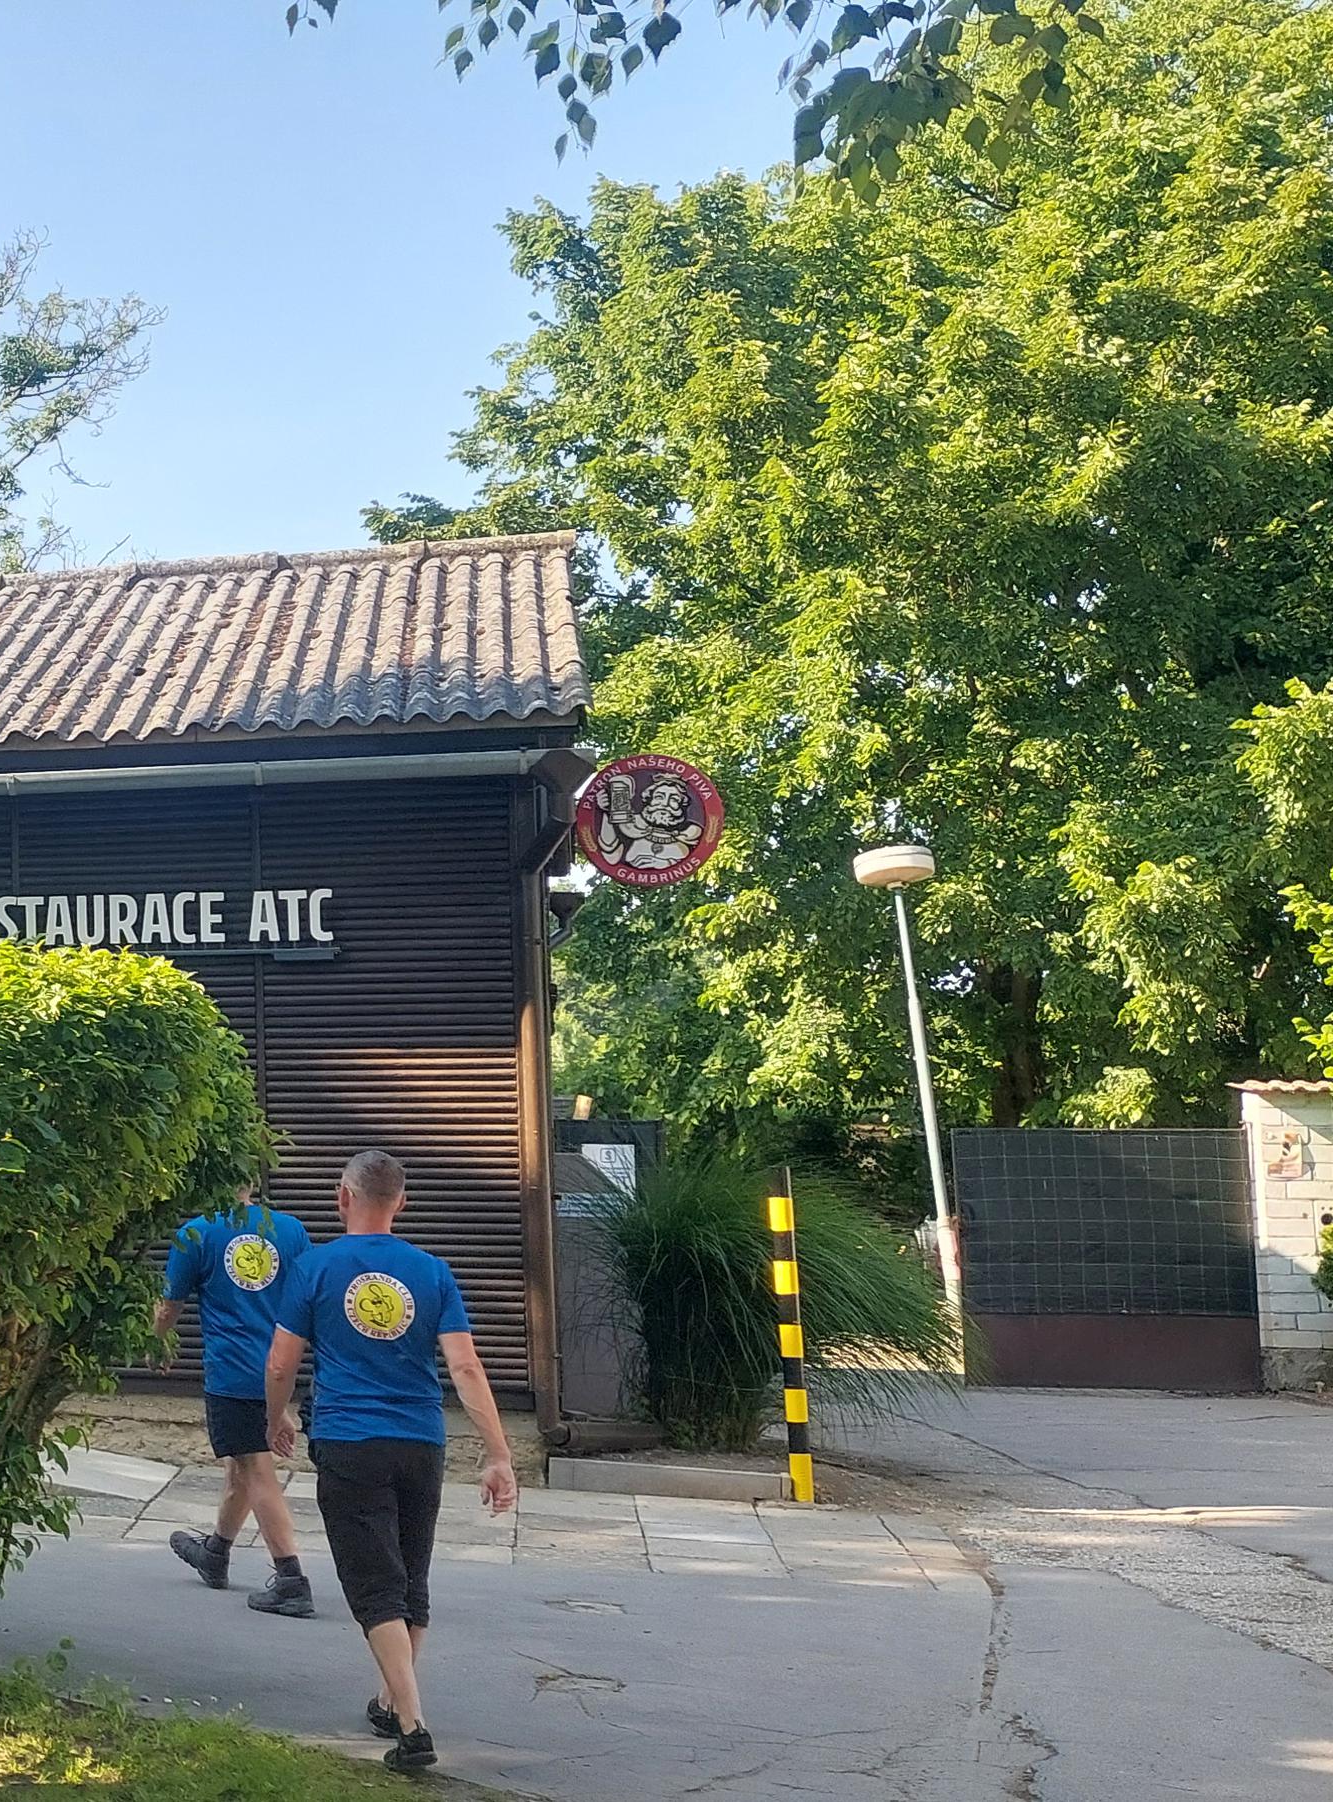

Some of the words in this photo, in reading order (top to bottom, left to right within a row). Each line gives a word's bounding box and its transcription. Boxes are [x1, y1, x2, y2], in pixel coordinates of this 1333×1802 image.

[582, 764, 622, 810] PATRON
[626, 755, 686, 774] NAŠEHO
[688, 771, 713, 801] PIVA
[616, 856, 701, 884] GAMBRINUS
[248, 888, 334, 943] ATC
[398, 1286, 414, 1310] CLUB
